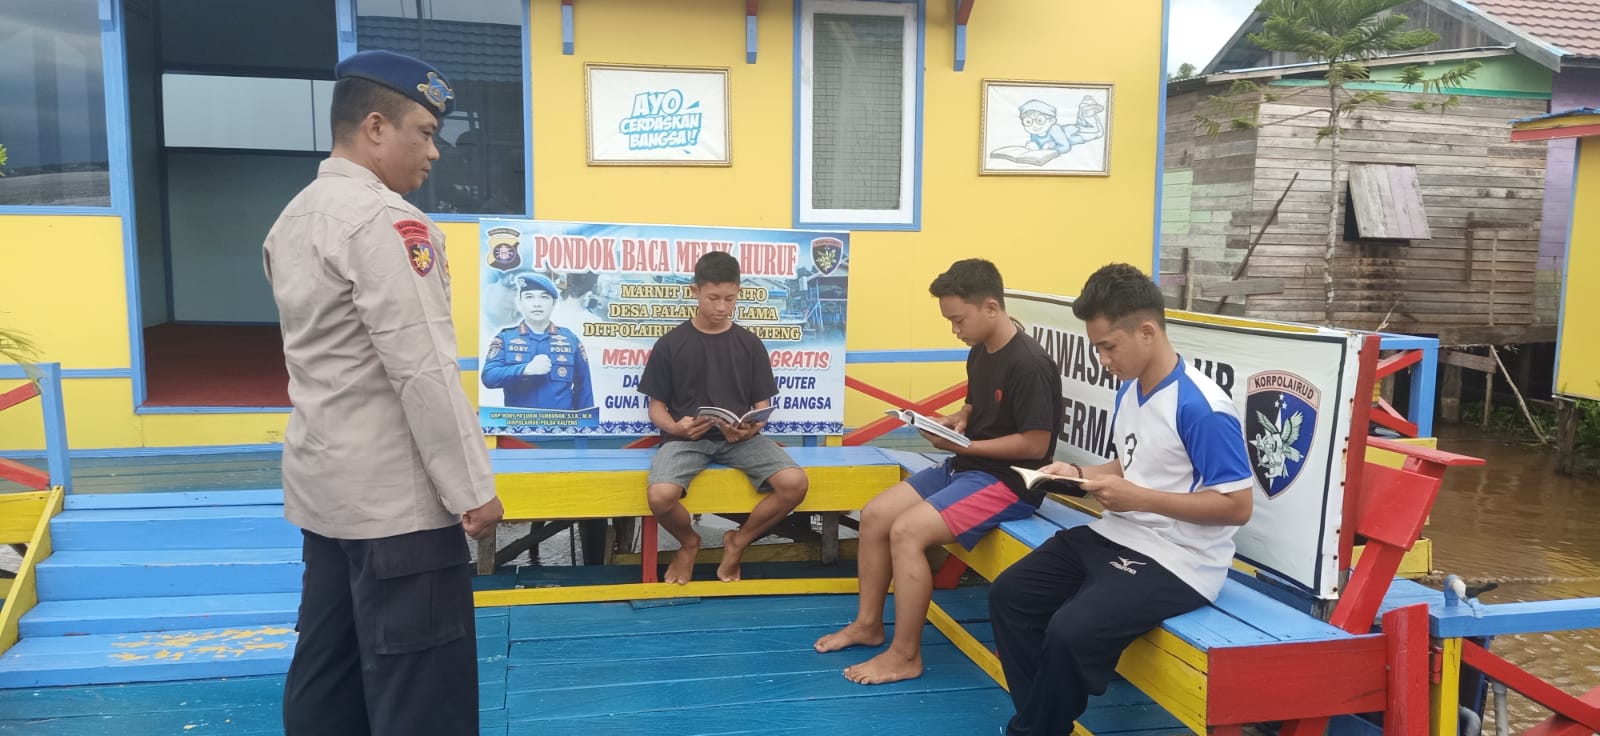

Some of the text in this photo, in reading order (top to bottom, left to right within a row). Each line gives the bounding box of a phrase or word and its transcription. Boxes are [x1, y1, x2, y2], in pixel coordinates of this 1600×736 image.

[631, 89, 683, 119] AYO
[619, 112, 702, 135] CERDASKAN
[534, 236, 616, 270] PONDOK
[622, 239, 669, 272] BACA
[740, 243, 797, 276] HURUF
[621, 285, 679, 299] MARNIT
[609, 303, 649, 318] DESA
[738, 306, 778, 320] LAMA
[583, 323, 677, 337] DITPOLAIRU
[602, 348, 830, 369] MENY GRATIS
[1254, 375, 1315, 400] KORPOLAIRUD
[605, 395, 640, 409] GUNA
[783, 396, 832, 410] BANGSA
